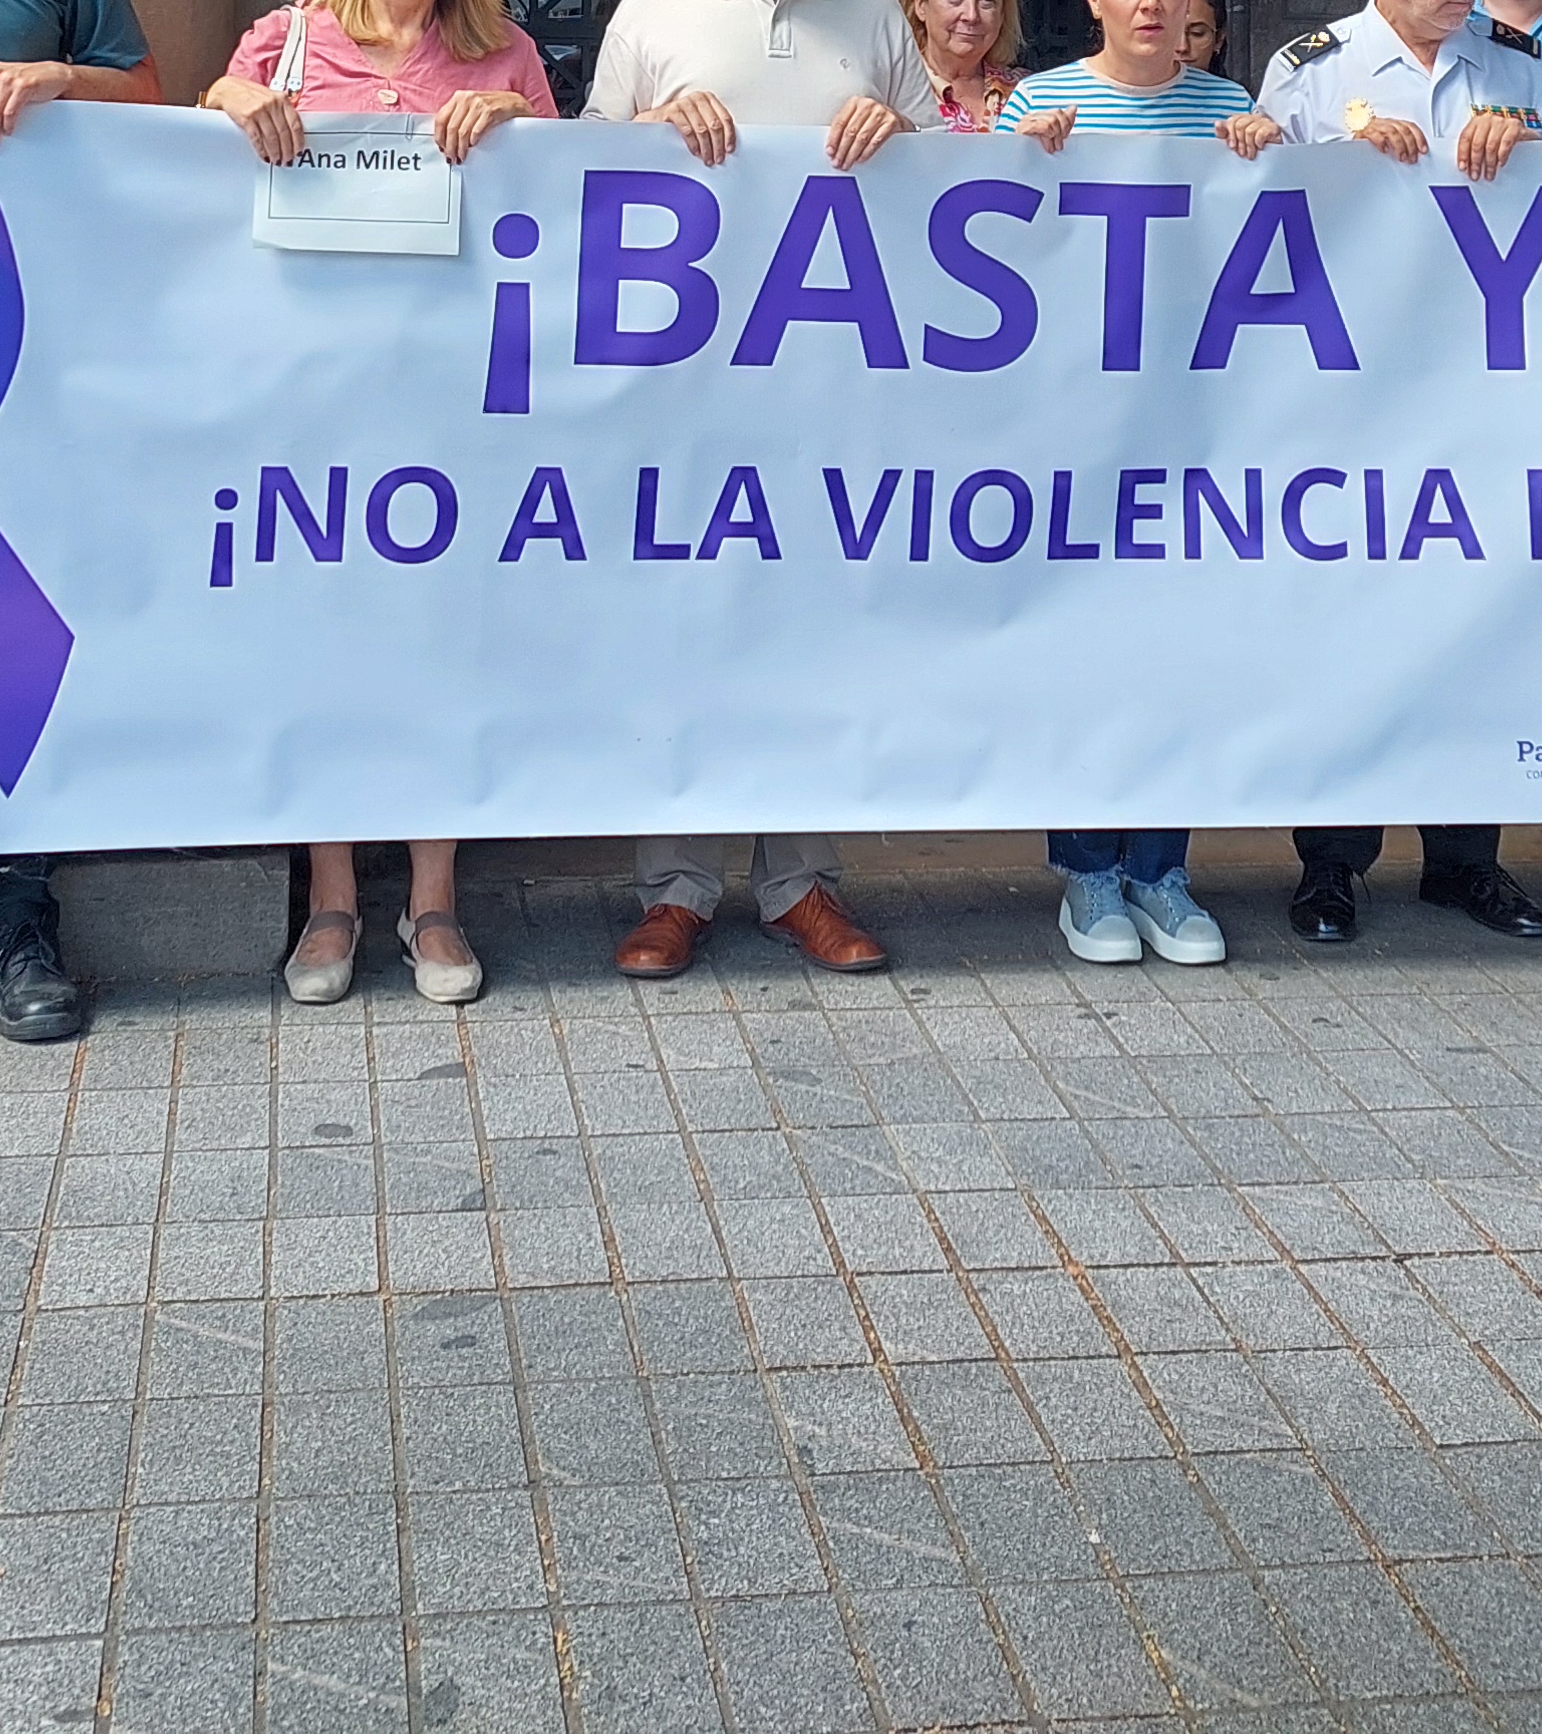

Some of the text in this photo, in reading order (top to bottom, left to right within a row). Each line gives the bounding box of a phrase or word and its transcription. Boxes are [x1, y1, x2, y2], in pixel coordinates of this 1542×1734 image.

[297, 148, 422, 171] Ana Milet
[483, 170, 1361, 414] ¡BASTA
[209, 465, 459, 588] ¡NO
[497, 465, 588, 562] A
[632, 465, 783, 561] LA
[822, 467, 1487, 563] VIOLENCIA
